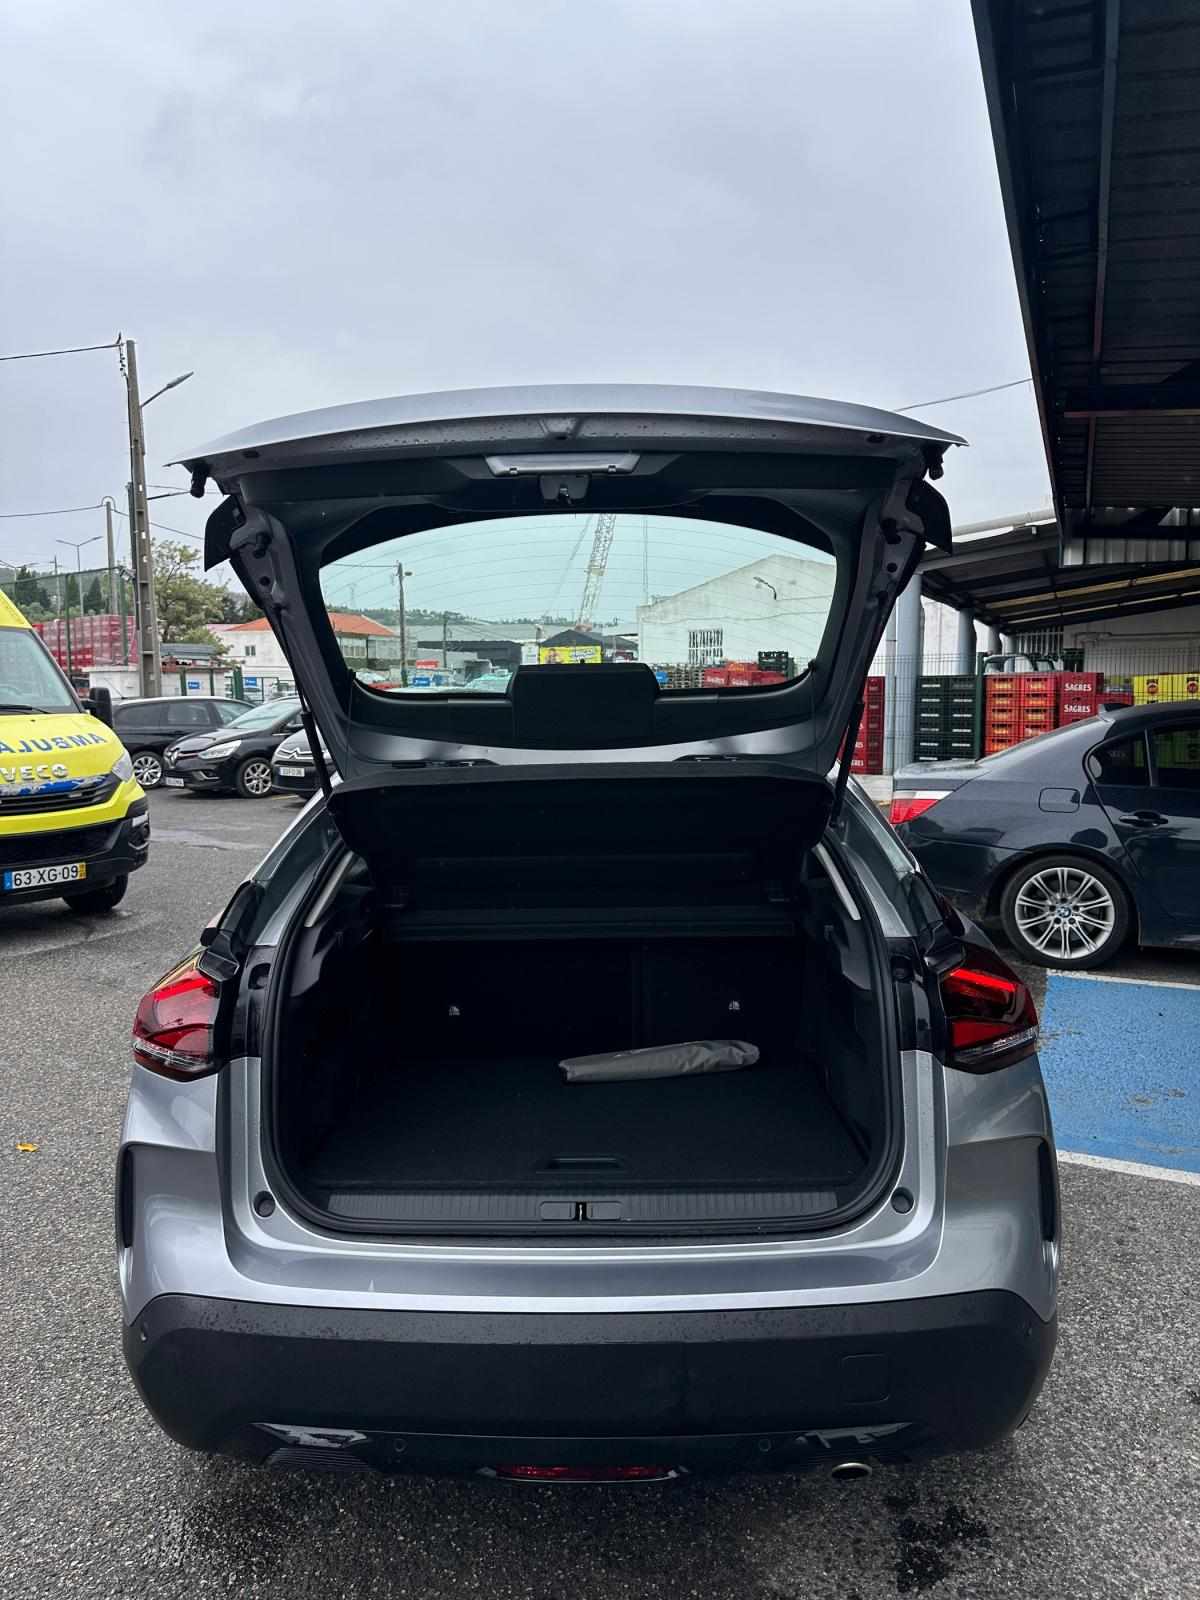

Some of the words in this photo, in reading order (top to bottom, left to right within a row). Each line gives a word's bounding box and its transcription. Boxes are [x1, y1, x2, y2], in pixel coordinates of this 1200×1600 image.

[1064, 683, 1092, 691] SAGRES
[1063, 704, 1091, 712] SAGRES
[0, 764, 69, 782] VECO
